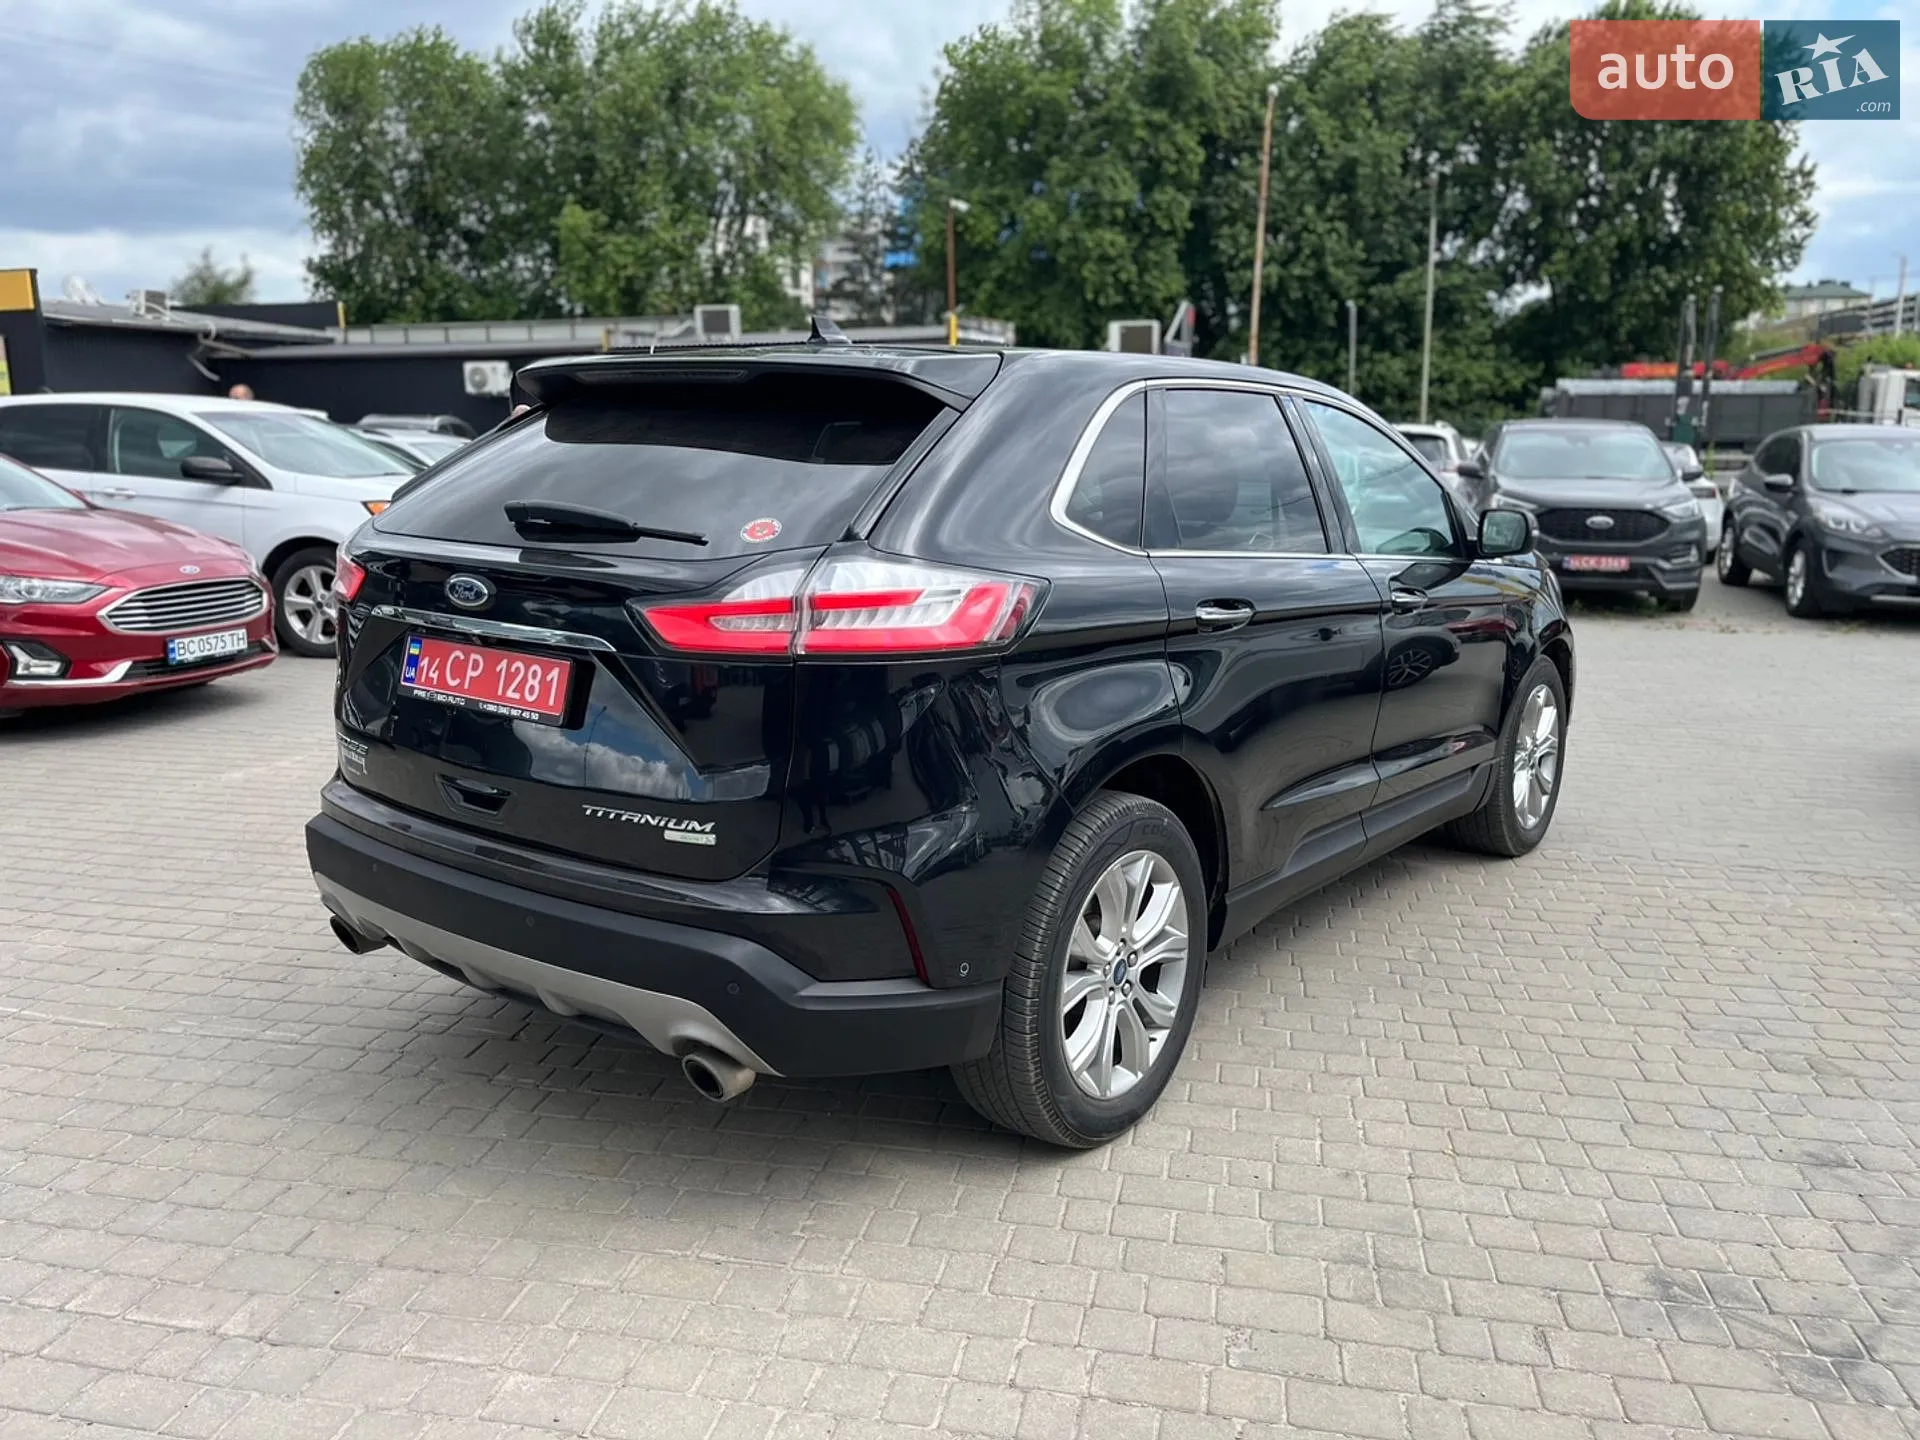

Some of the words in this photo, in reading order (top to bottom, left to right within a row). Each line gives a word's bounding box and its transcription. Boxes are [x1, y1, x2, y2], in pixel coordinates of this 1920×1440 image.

[454, 582, 477, 600] Ford
[177, 640, 196, 657] BC
[198, 635, 227, 653] 0575
[228, 632, 246, 648] TH
[405, 666, 416, 678] UA
[420, 656, 440, 685] 14
[445, 650, 484, 689] CP
[496, 659, 560, 706] 1281
[582, 804, 716, 832] TITANIUM
